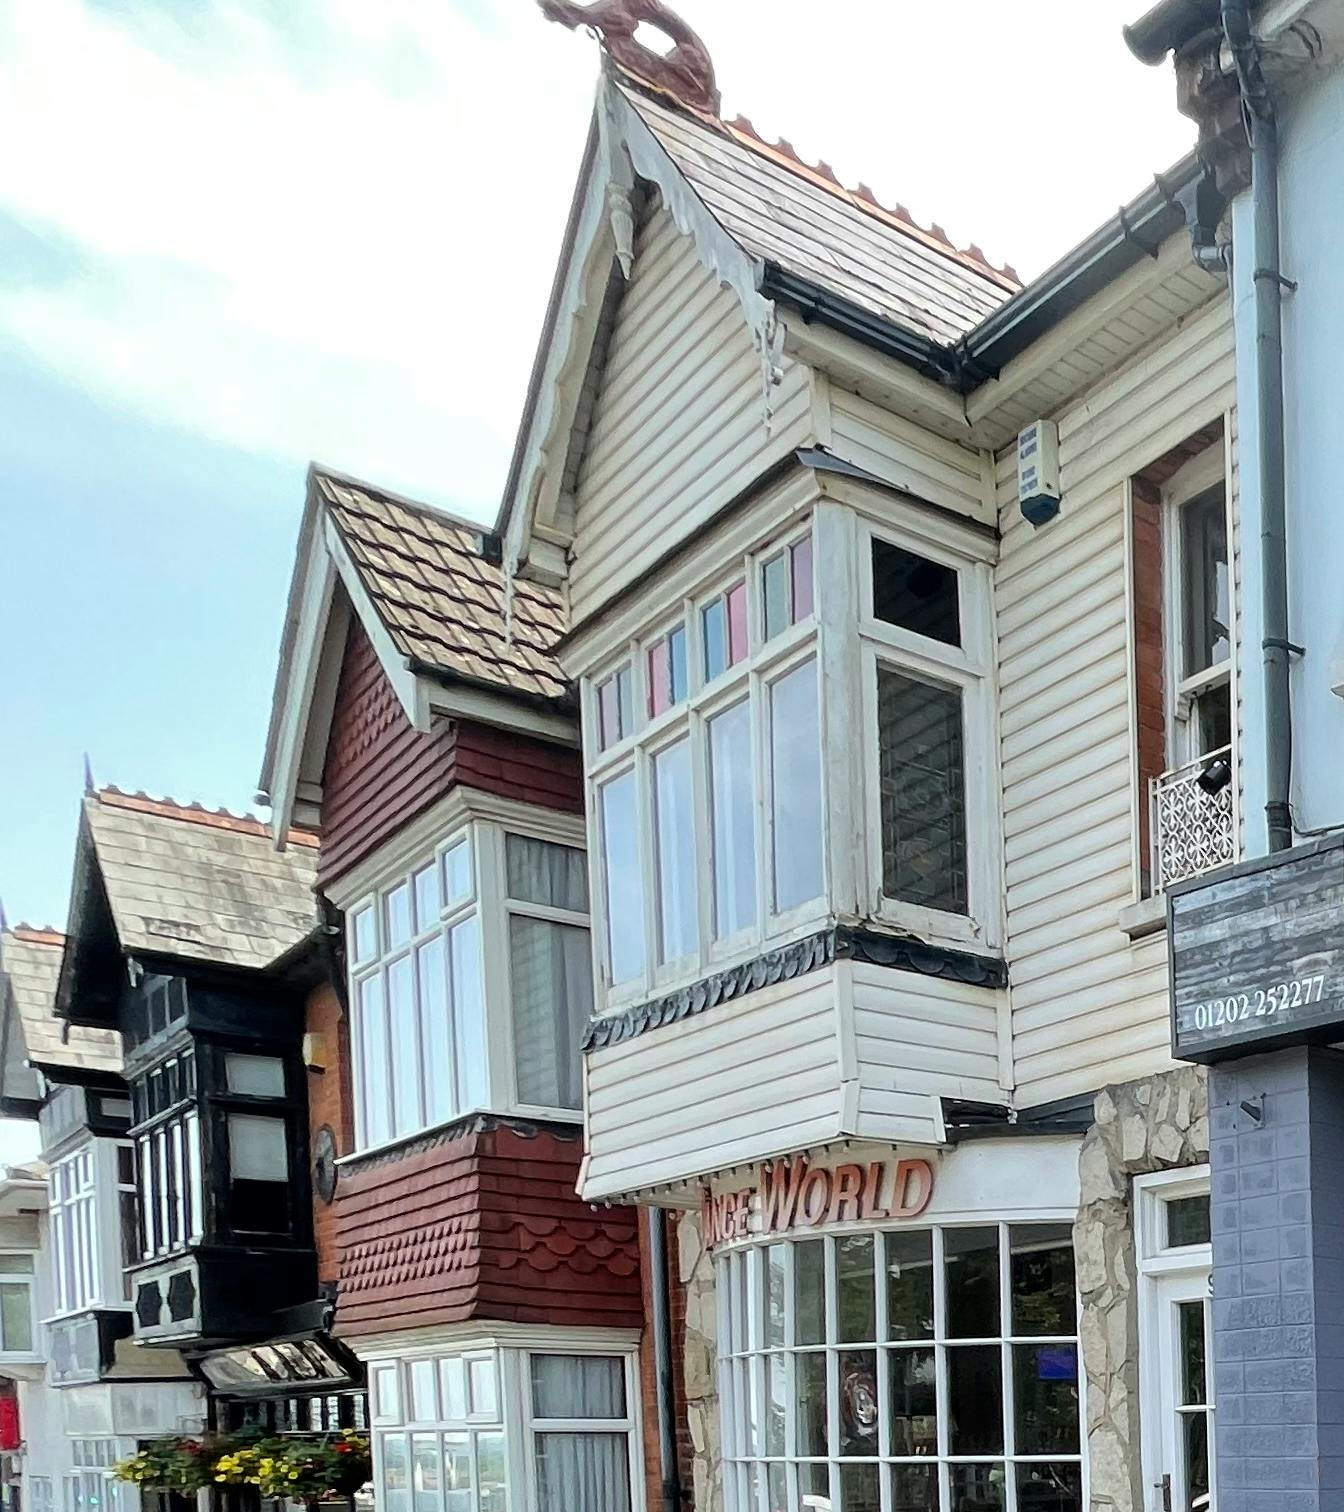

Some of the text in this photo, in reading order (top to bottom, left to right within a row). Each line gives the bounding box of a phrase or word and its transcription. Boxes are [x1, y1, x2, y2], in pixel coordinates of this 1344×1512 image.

[1194, 974, 1326, 1031] 01202 252277
[760, 1153, 935, 1235] WORLD
